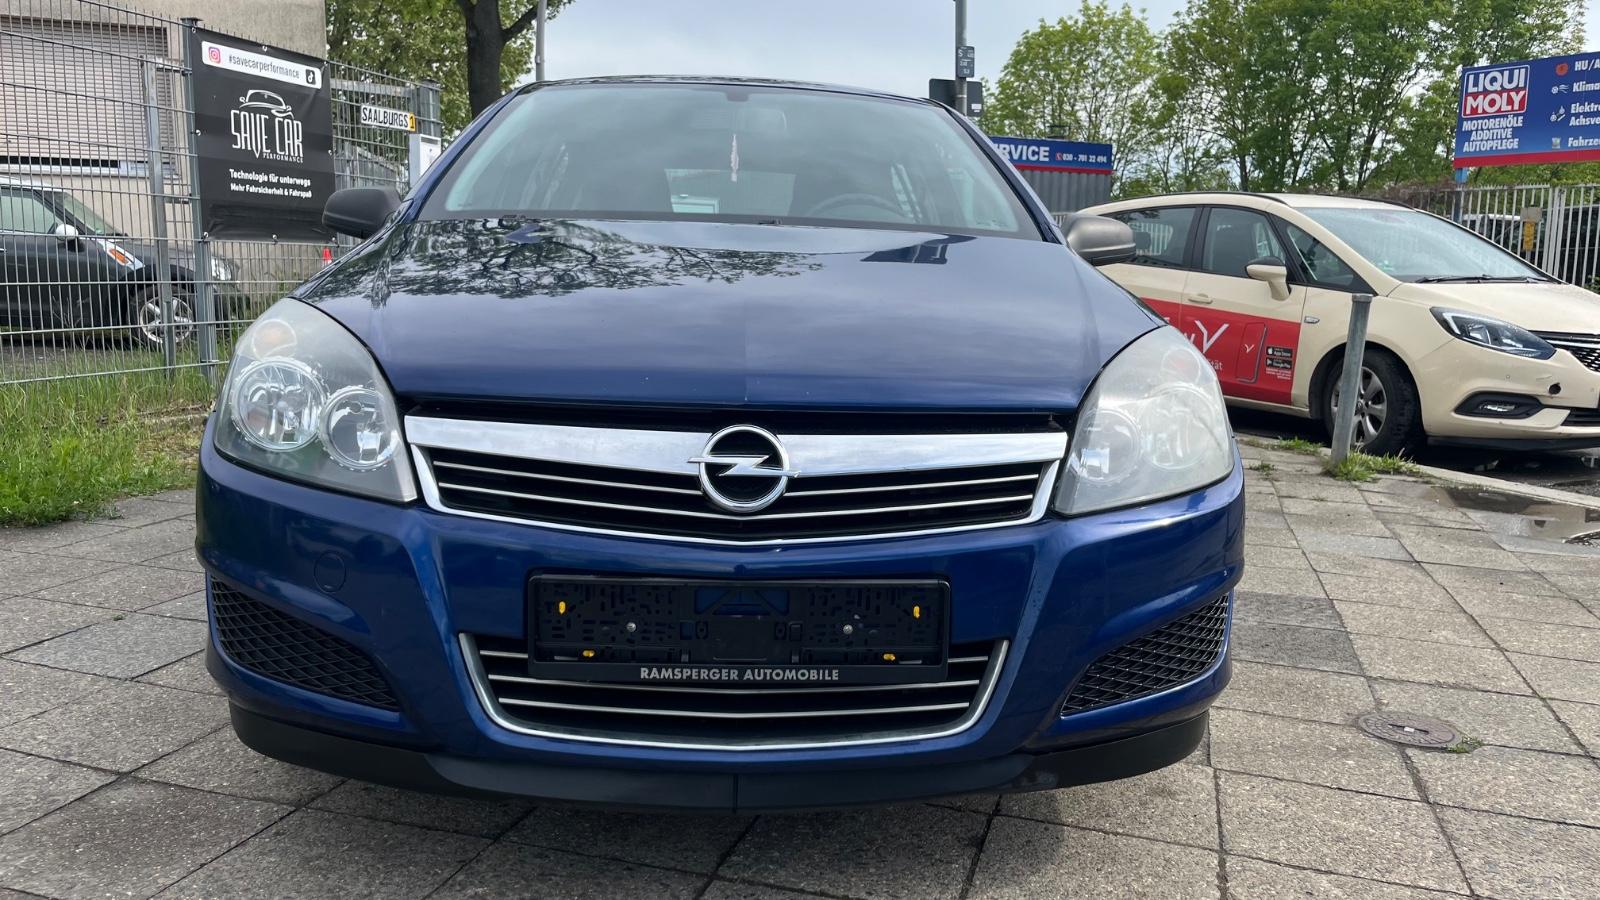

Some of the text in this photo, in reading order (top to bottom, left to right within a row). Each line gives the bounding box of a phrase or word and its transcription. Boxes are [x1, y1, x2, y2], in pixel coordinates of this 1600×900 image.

[229, 55, 300, 79] #savecarperformance
[1467, 68, 1526, 93] LIQUI
[1465, 90, 1525, 114] MOLY
[362, 107, 408, 128] SAALBURGS
[1462, 115, 1524, 131] MOTORENÖLE
[231, 110, 303, 158] SAVE CAR
[1470, 128, 1513, 141] ADDITIVE
[1568, 136, 1600, 147] Fahrze
[1463, 138, 1519, 152] AUTOPFLEGE
[263, 153, 304, 163] PERFORMANCE
[229, 169, 311, 187] Technologie für unterwegs
[230, 183, 245, 192] Mehr
[640, 667, 839, 681] RAMSPERGER AUTOMOBILE
